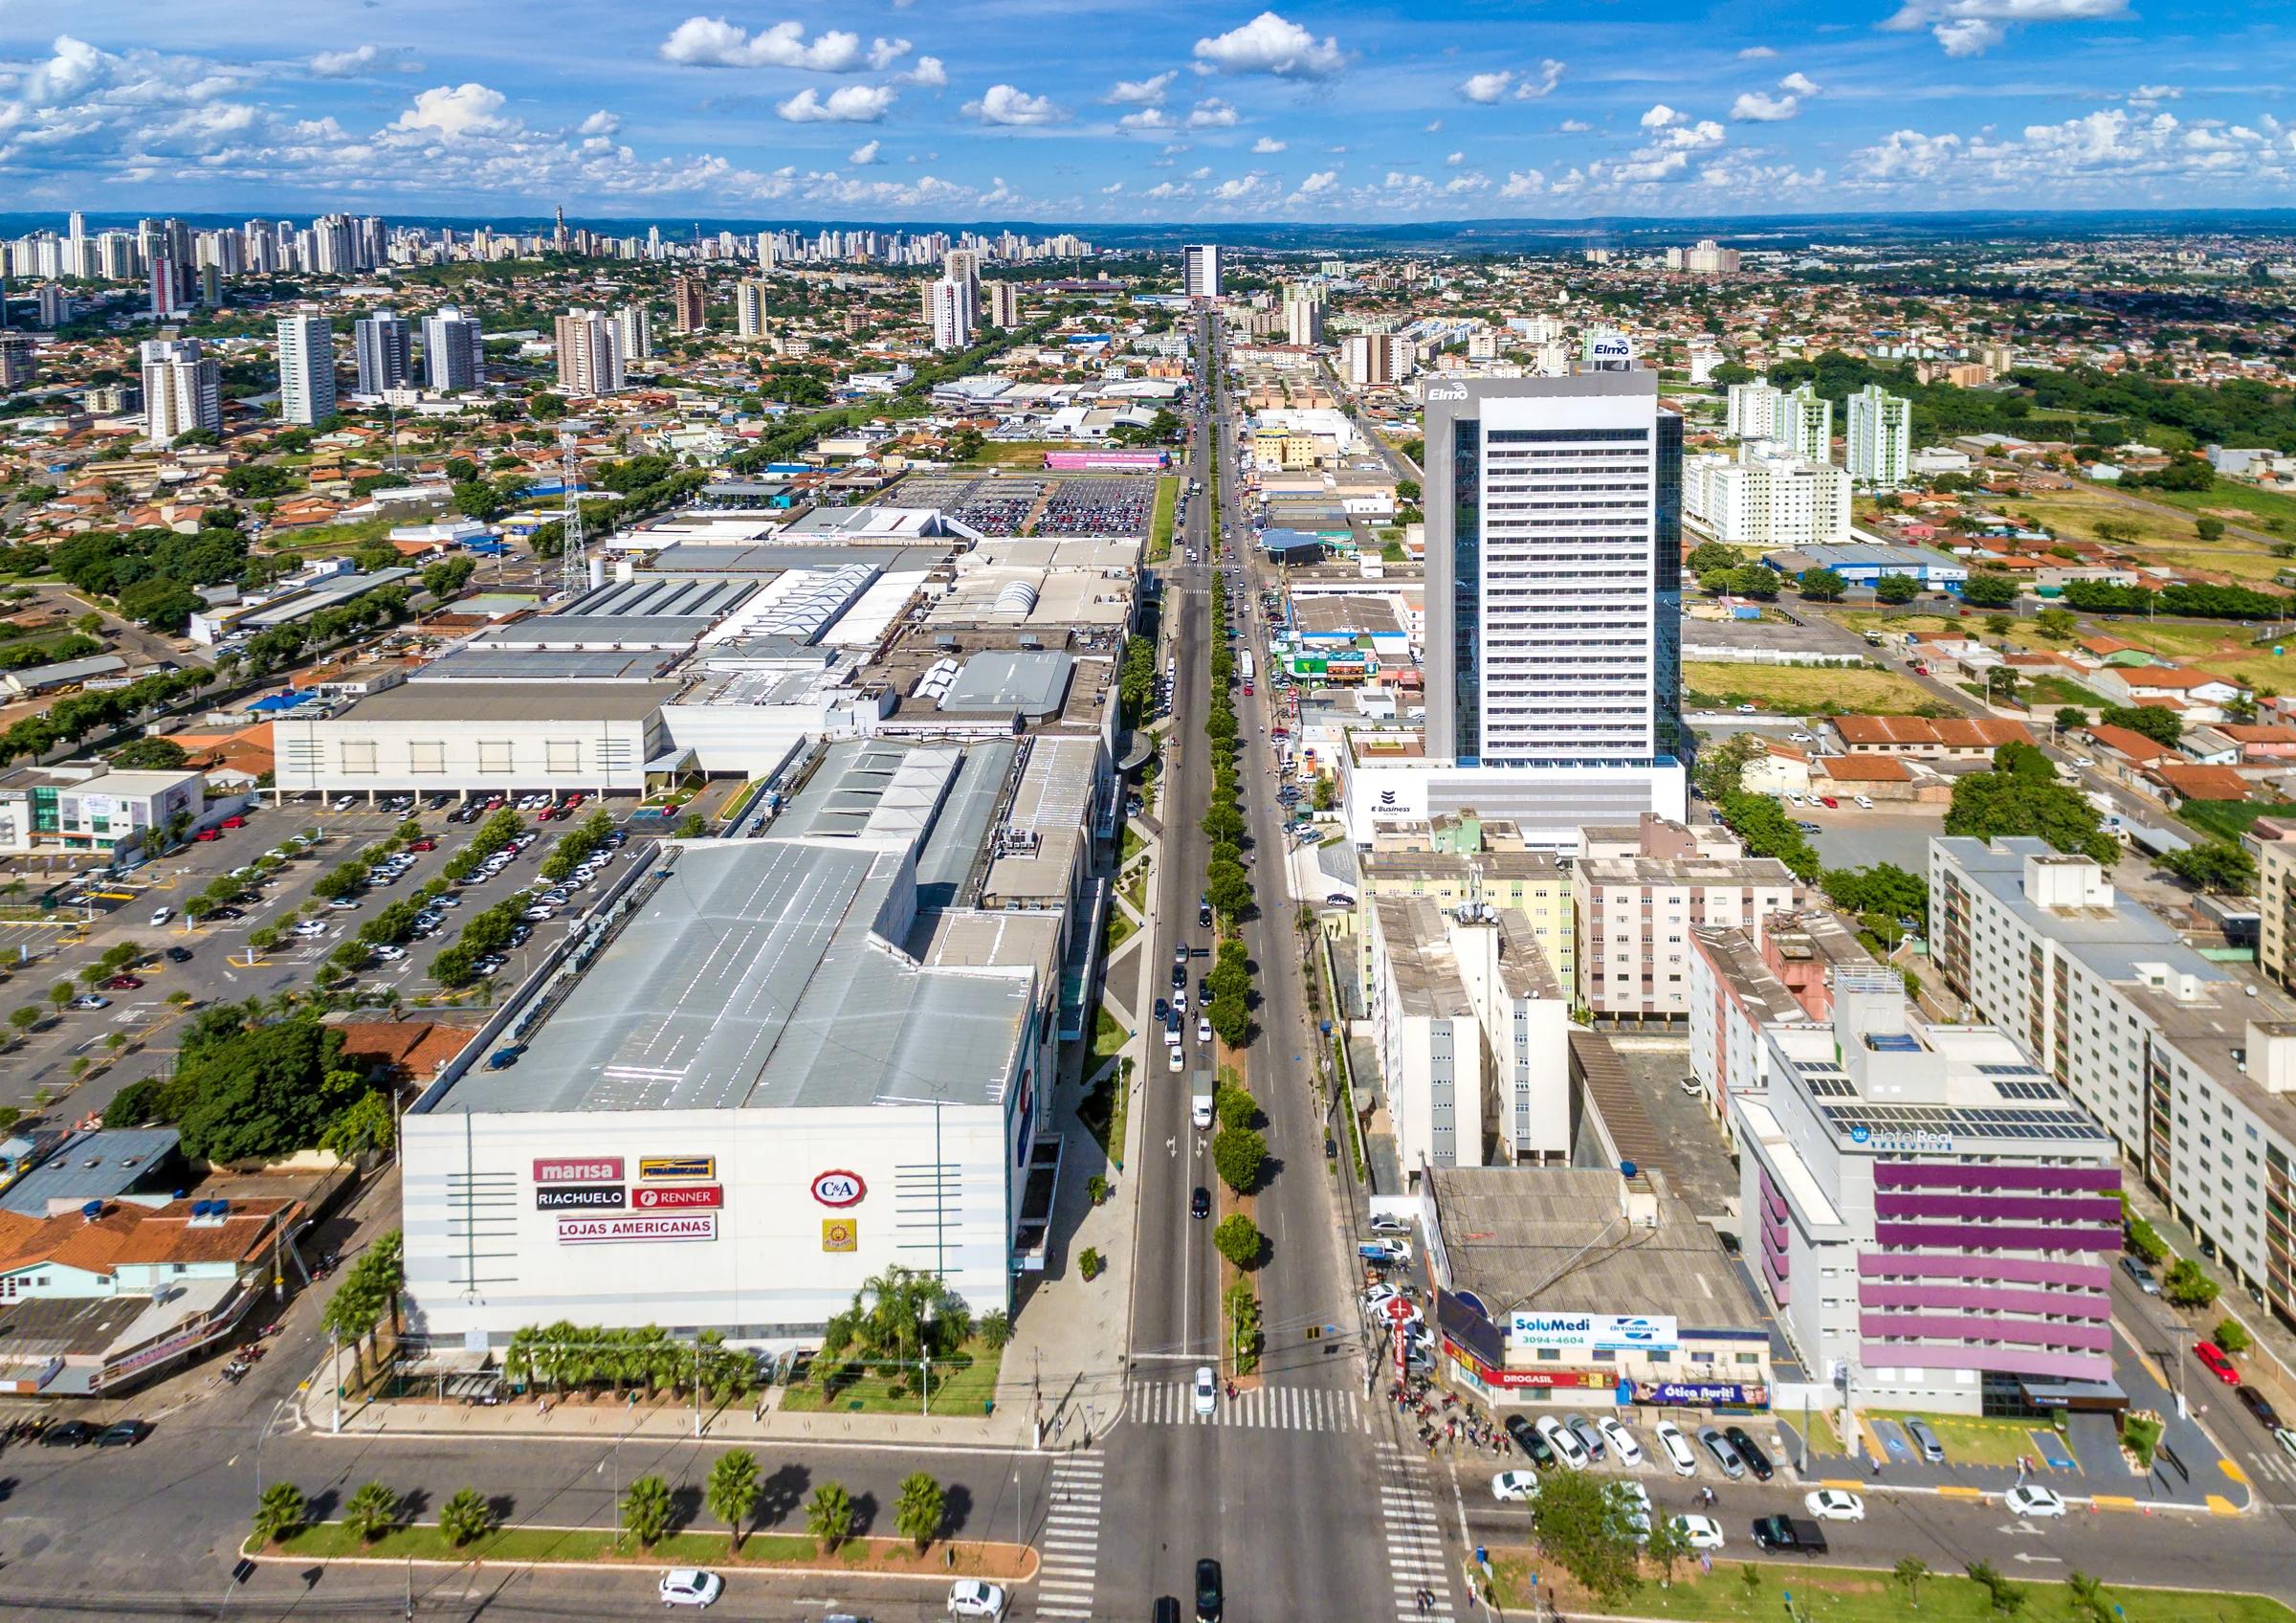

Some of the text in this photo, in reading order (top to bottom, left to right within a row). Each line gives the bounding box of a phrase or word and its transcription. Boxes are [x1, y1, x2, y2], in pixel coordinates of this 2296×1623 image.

[1594, 344, 1629, 355] Elmo
[1427, 388, 1468, 401] Elmo
[1870, 1142, 1953, 1151] EXECUTIVE
[541, 1164, 613, 1180] marisa
[821, 1181, 853, 1196] C&A
[538, 1191, 623, 1205] RIACHUELO
[660, 1191, 711, 1203] RENNER
[559, 1220, 712, 1235] LOJAS AMERICANAS
[1515, 1318, 1590, 1332] SoluMedi
[1522, 1335, 1585, 1345] 3094-4604
[1503, 1374, 1554, 1384] DROGASIL
[1665, 1385, 1734, 1398] Ótica Buriti
